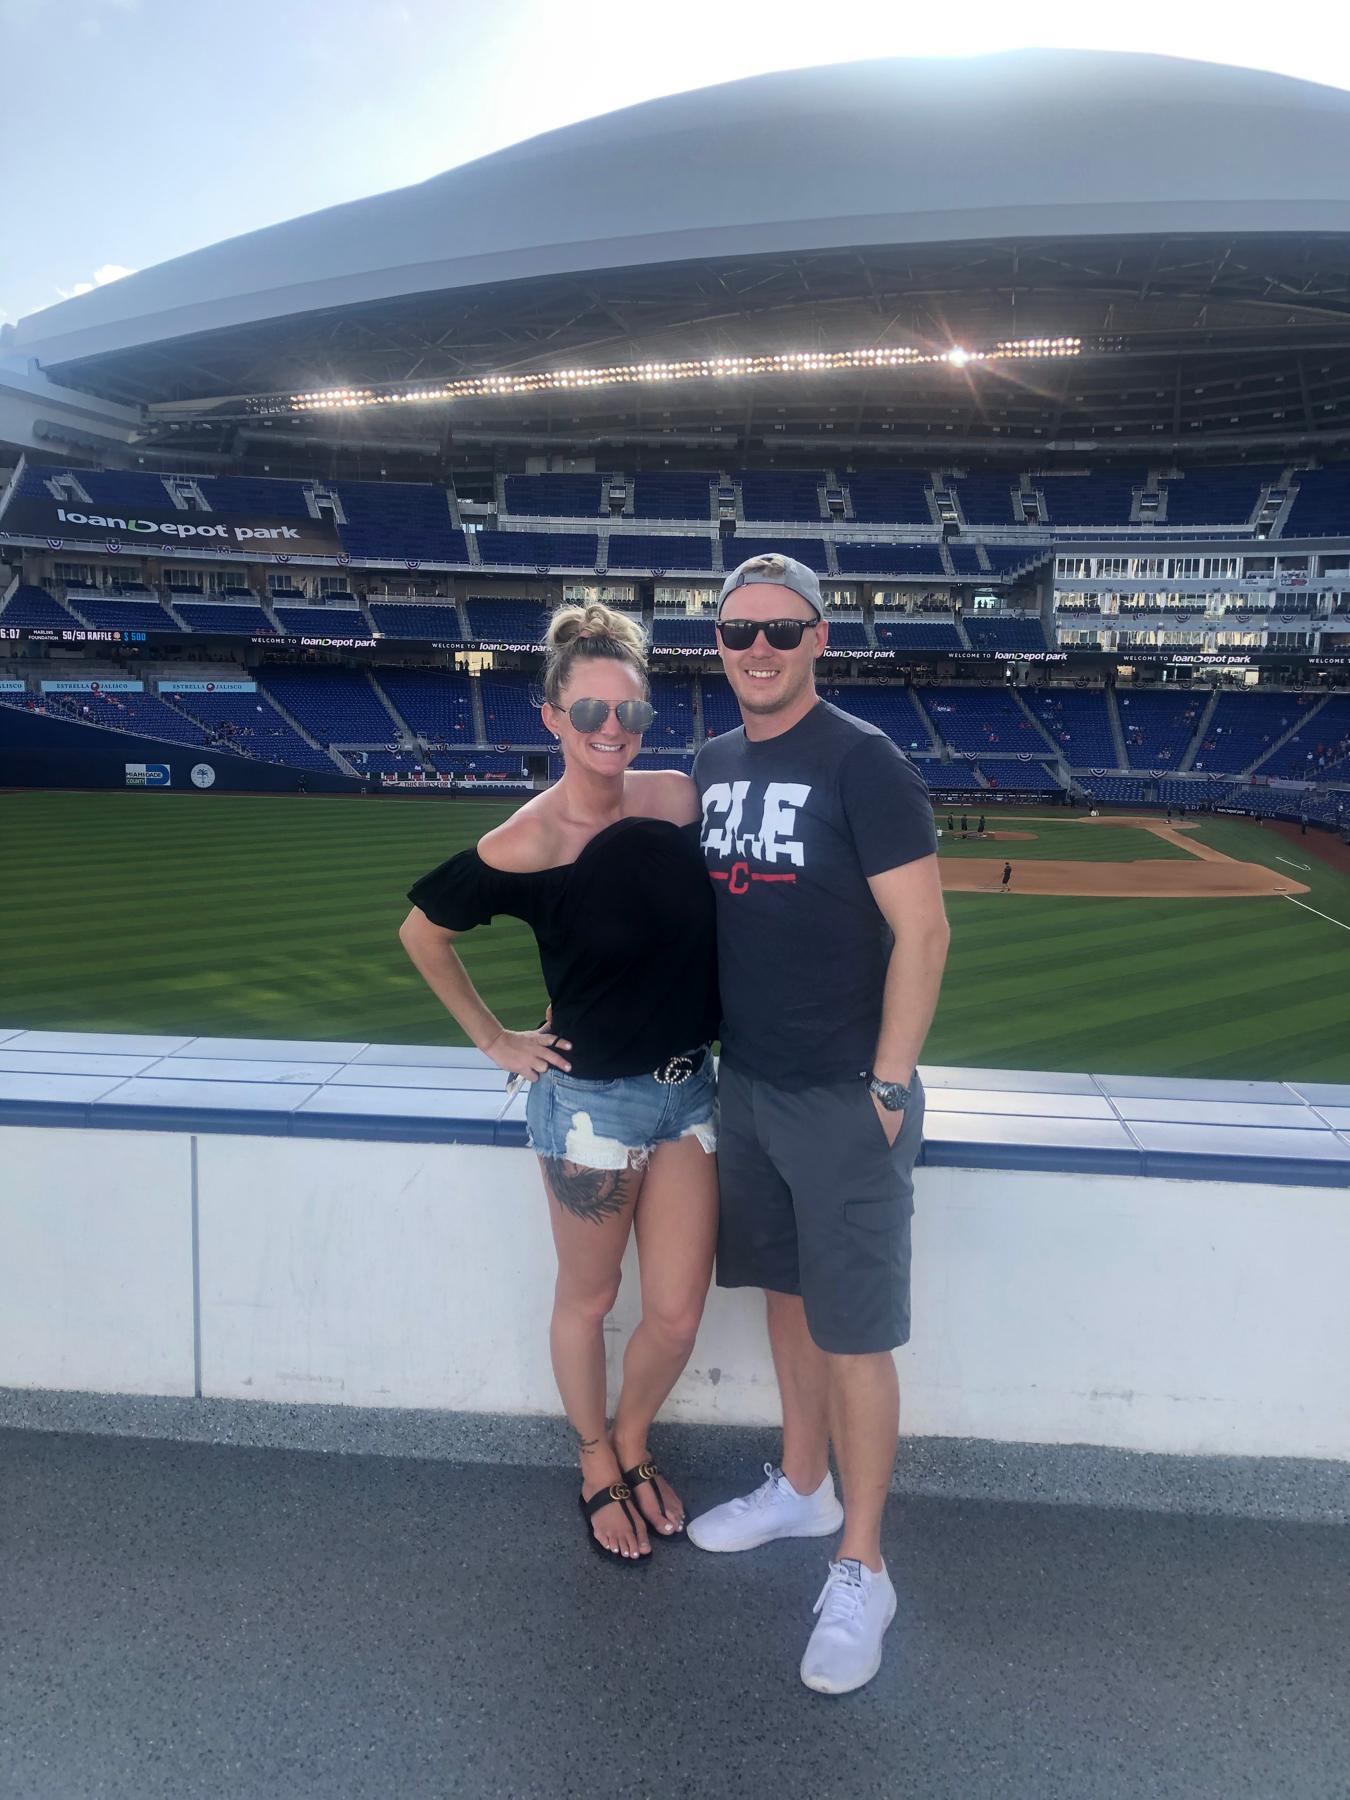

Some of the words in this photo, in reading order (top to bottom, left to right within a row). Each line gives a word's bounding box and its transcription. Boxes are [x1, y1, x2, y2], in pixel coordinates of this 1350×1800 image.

[56, 508, 230, 538] loanDepot
[234, 525, 301, 541] park
[62, 630, 86, 641] 50/50
[87, 631, 112, 641] RAFFLE
[123, 632, 129, 642] $
[131, 632, 147, 641] 500
[300, 637, 354, 648] loanDepot
[354, 639, 377, 648] park
[479, 642, 530, 652] loanDepot
[652, 646, 702, 656] loanDepot
[702, 648, 721, 657] par
[822, 649, 872, 659] loanDepot
[873, 650, 896, 659] park
[994, 651, 1045, 661] loanDepot
[1045, 652, 1068, 661] park
[1172, 654, 1226, 664] loanDepot
[1227, 655, 1251, 665] park
[699, 780, 813, 867] CLE
[728, 861, 750, 894] C
